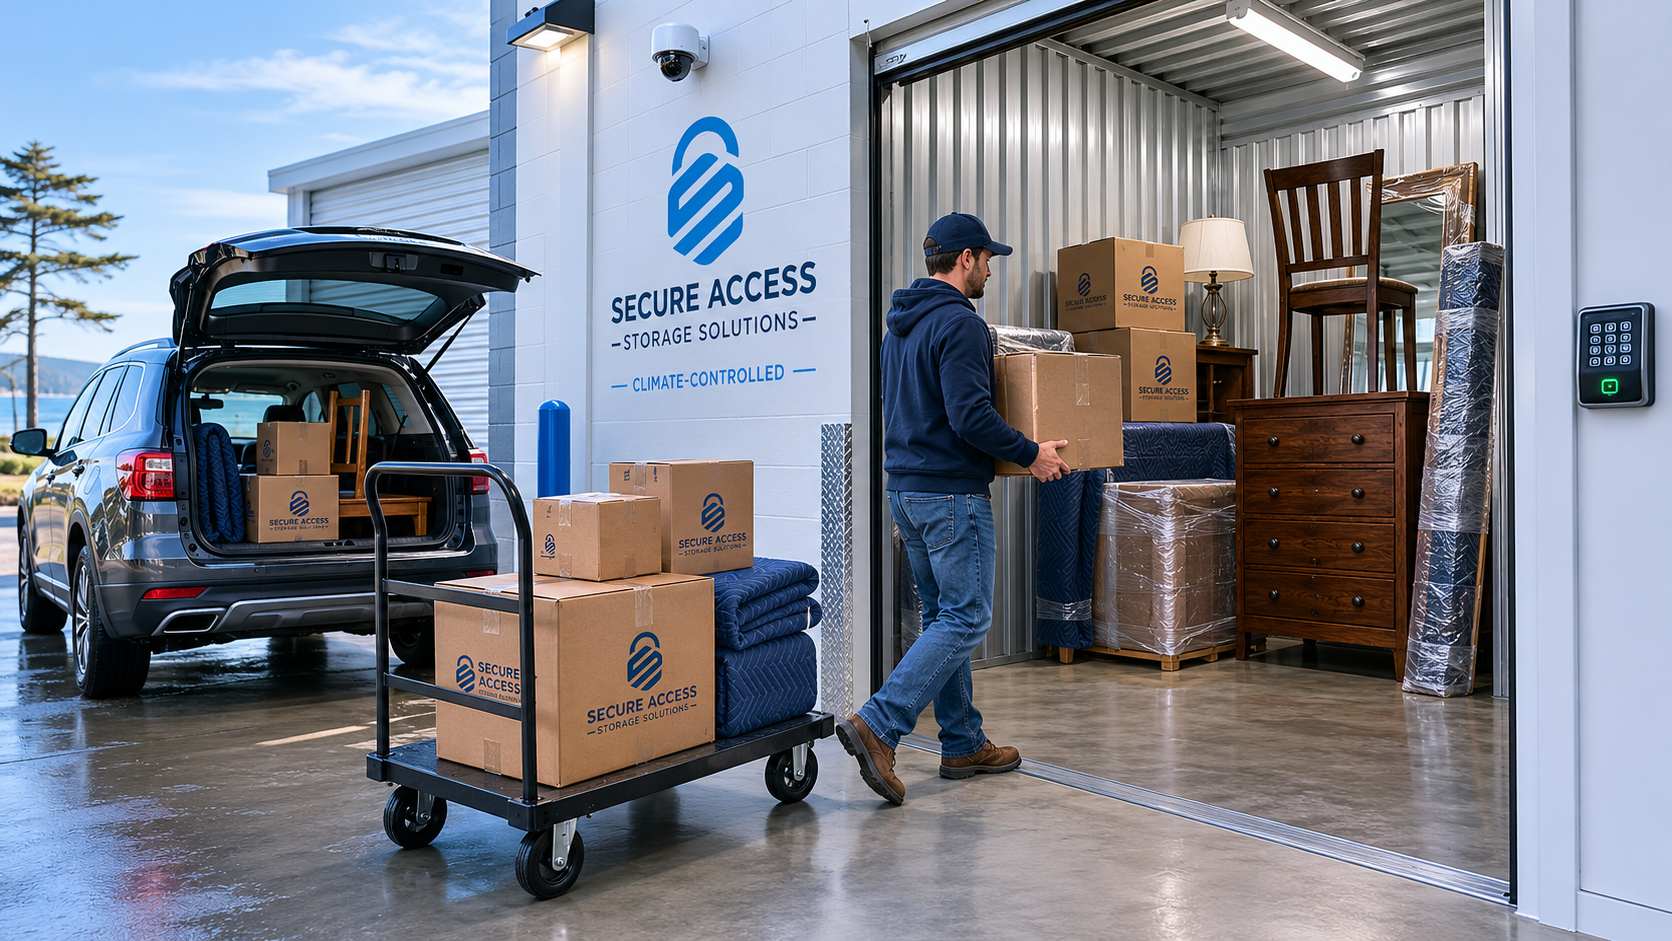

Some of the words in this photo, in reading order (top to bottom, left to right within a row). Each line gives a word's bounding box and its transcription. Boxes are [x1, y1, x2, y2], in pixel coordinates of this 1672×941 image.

[611, 282, 700, 324] SECURE
[707, 260, 817, 309] ACCESS
[1123, 293, 1149, 302] SECURE
[1151, 296, 1177, 306] ACCESS
[623, 326, 692, 351] STORAGE
[698, 310, 798, 341] SOLUTIONS
[632, 364, 785, 392] CLIMATE-CONTROLLED
[1138, 386, 1162, 394] SECURE
[1164, 387, 1189, 395] ACCESS
[300, 517, 329, 525] ACCESS
[678, 536, 713, 549] SECURE
[715, 532, 747, 544] ACCESS
[478, 661, 520, 681] SECURE
[479, 676, 521, 695] ACCESS
[587, 698, 644, 724] SECURE
[647, 685, 697, 709] ACCESS
[597, 715, 640, 735] STORAGE
[643, 703, 689, 722] SOLUTIONS
